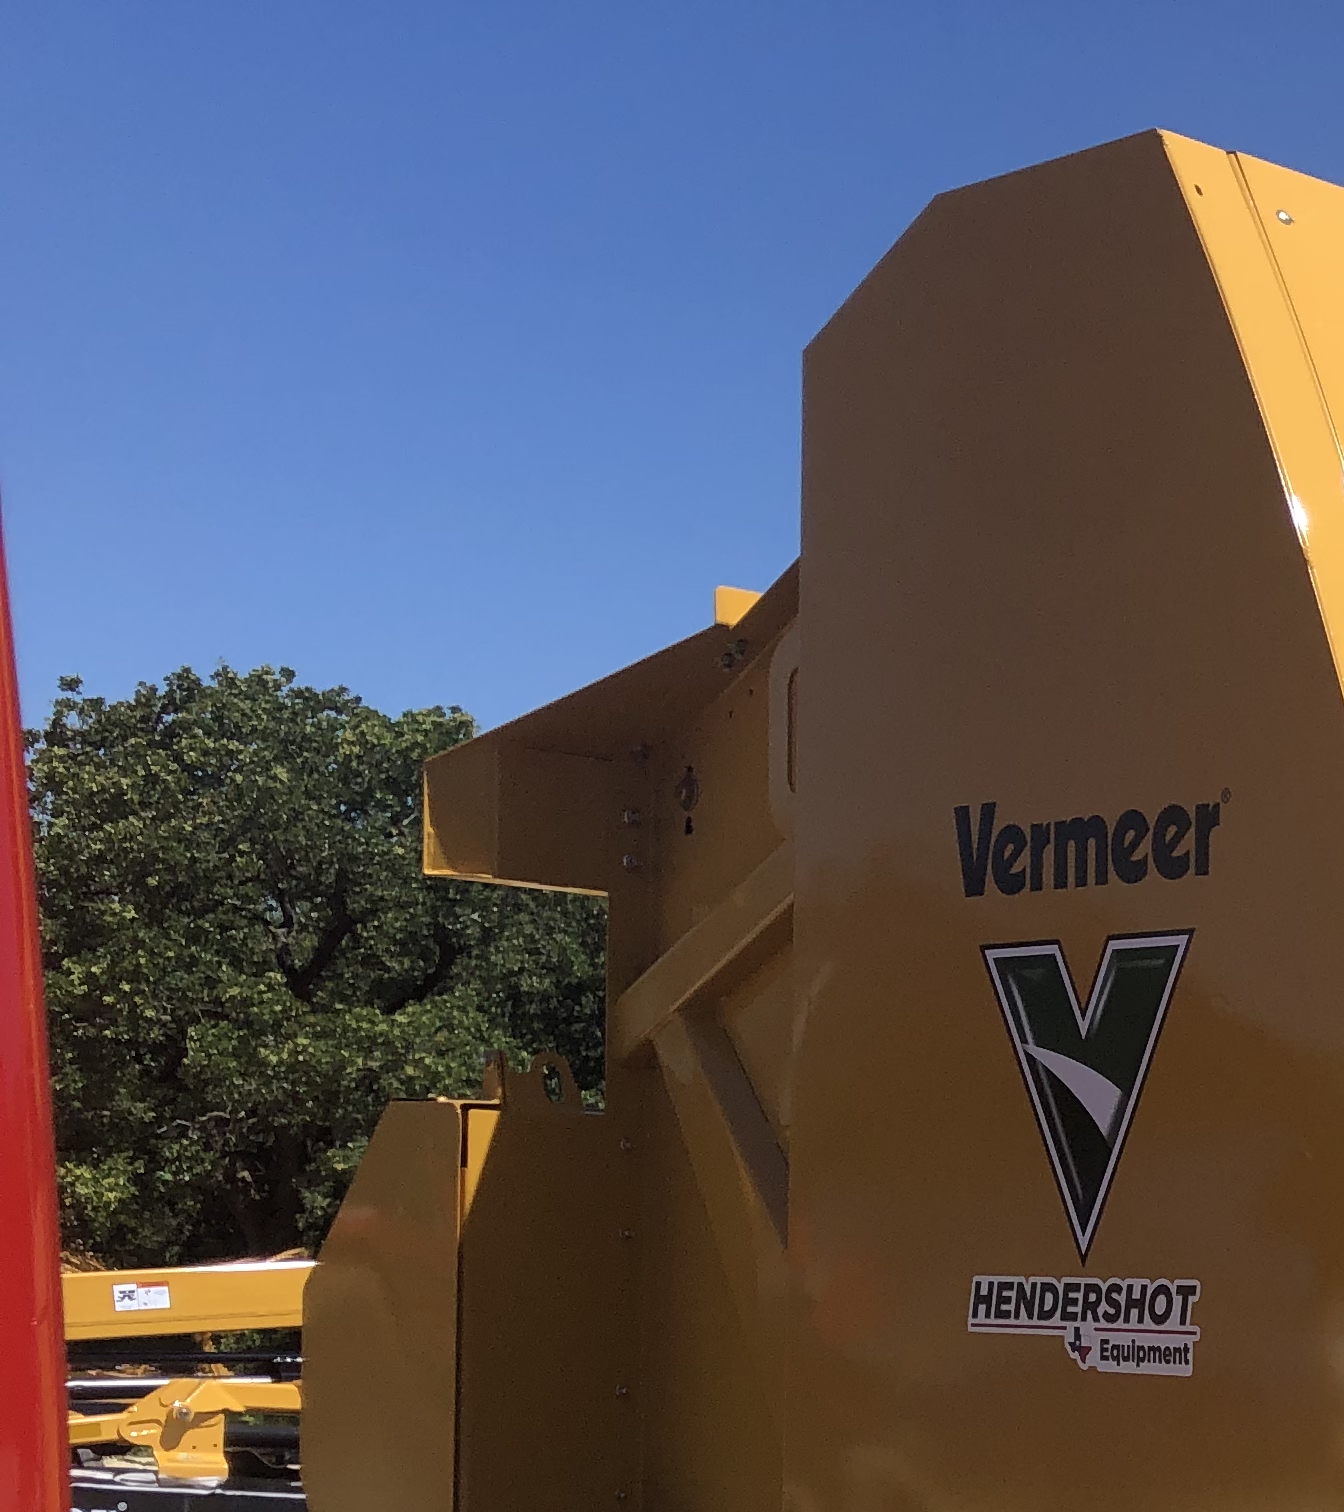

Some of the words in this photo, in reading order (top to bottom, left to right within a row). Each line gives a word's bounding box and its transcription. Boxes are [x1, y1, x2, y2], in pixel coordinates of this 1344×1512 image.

[954, 801, 1222, 899] Vermeer
[972, 1279, 1198, 1326] HENDERSHOT
[1099, 1337, 1191, 1369] Equipment
